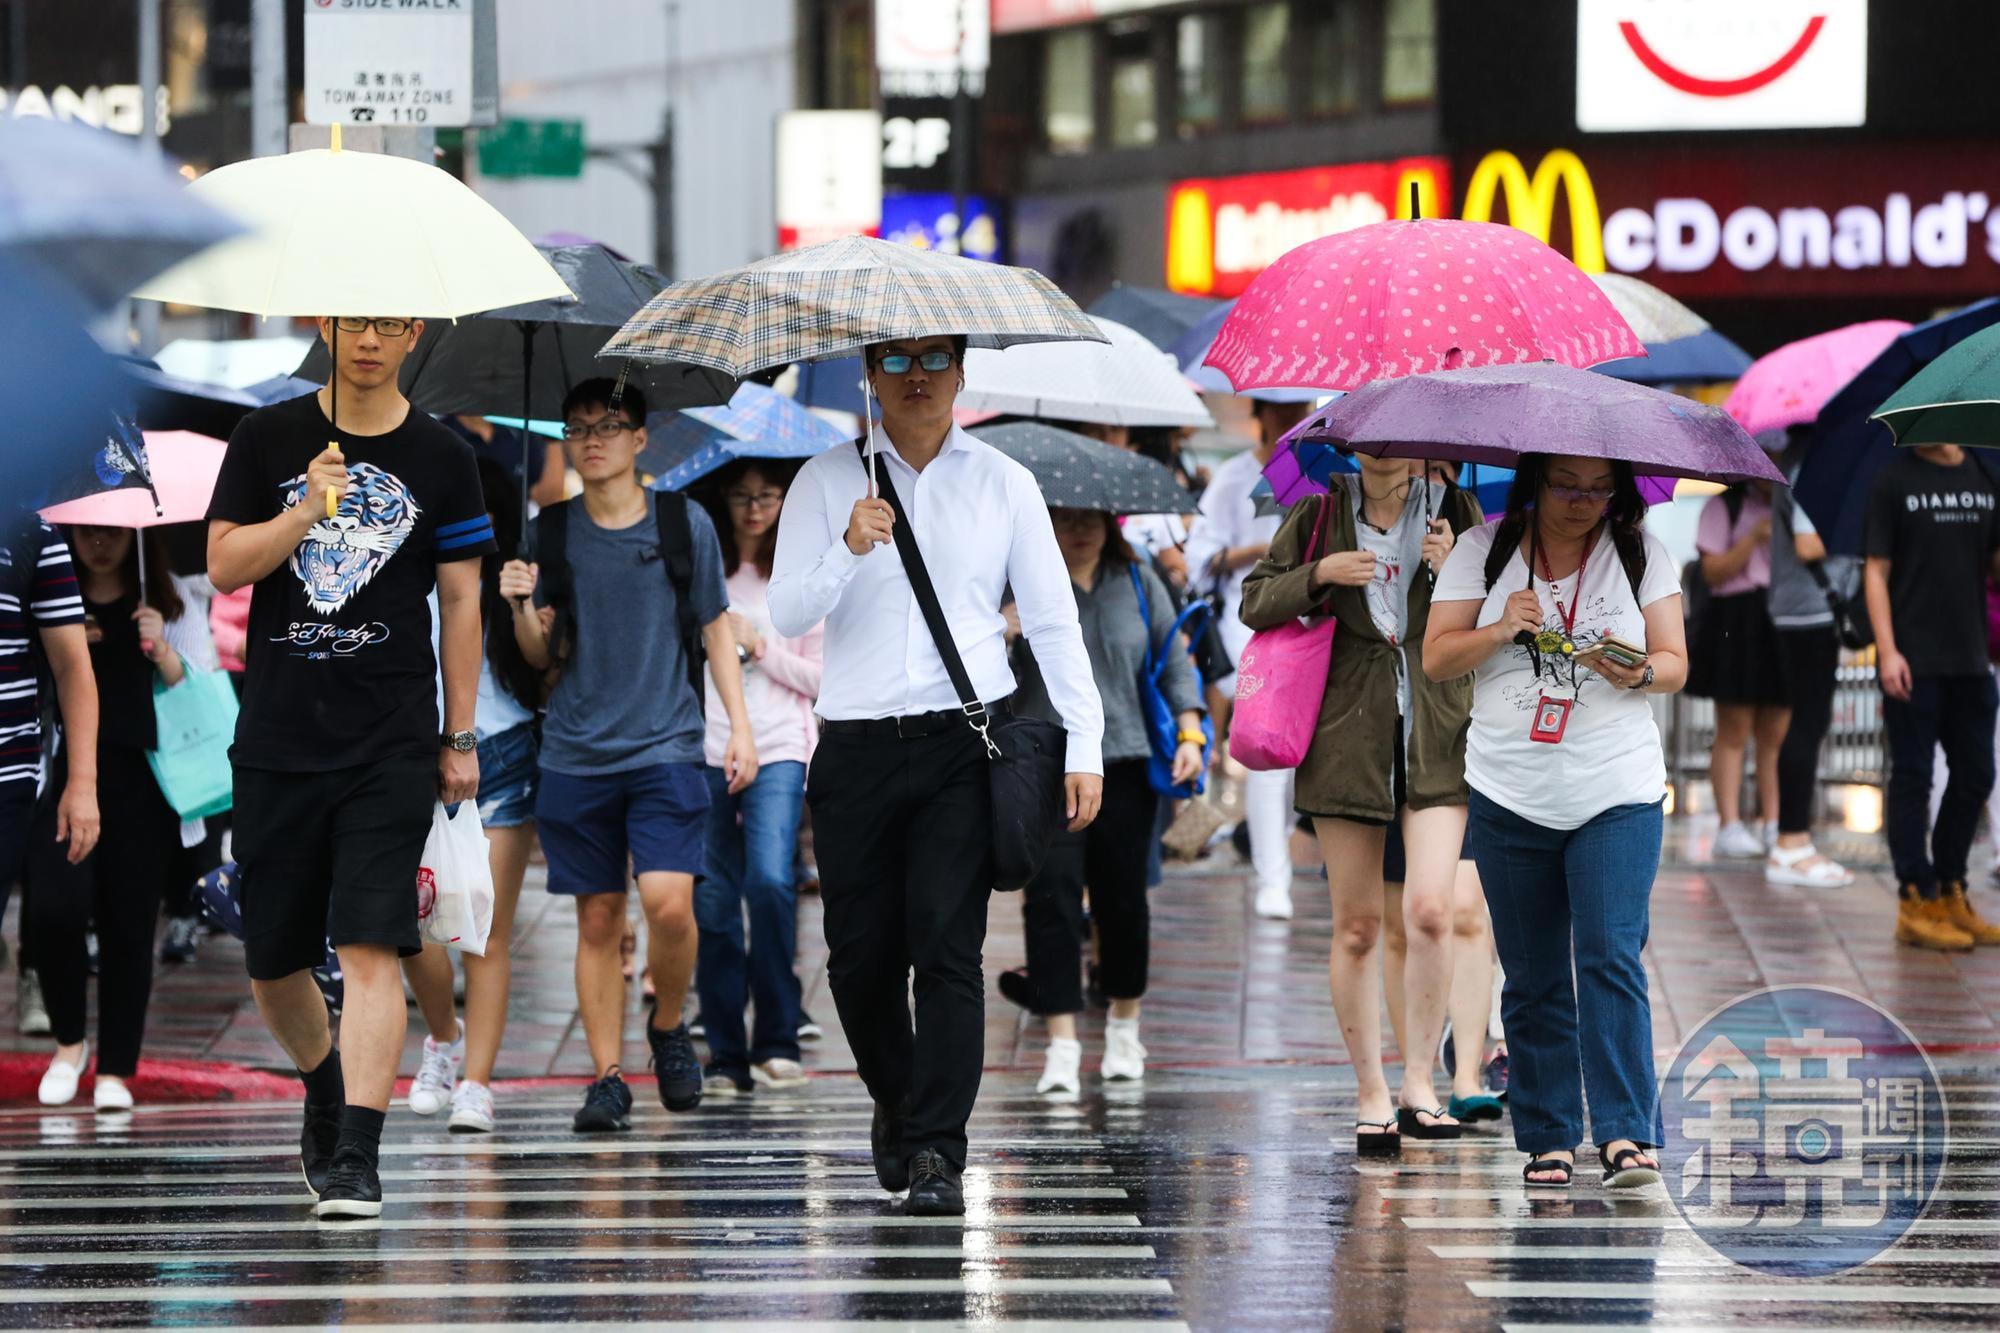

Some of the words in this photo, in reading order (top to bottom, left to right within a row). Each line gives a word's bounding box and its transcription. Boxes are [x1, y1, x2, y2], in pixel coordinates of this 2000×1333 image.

[324, 89, 405, 104] TOW-AWAY
[413, 89, 454, 104] ZONE
[391, 108, 428, 122] 110
[882, 116, 951, 168] 2F
[1585, 594, 1605, 610] La
